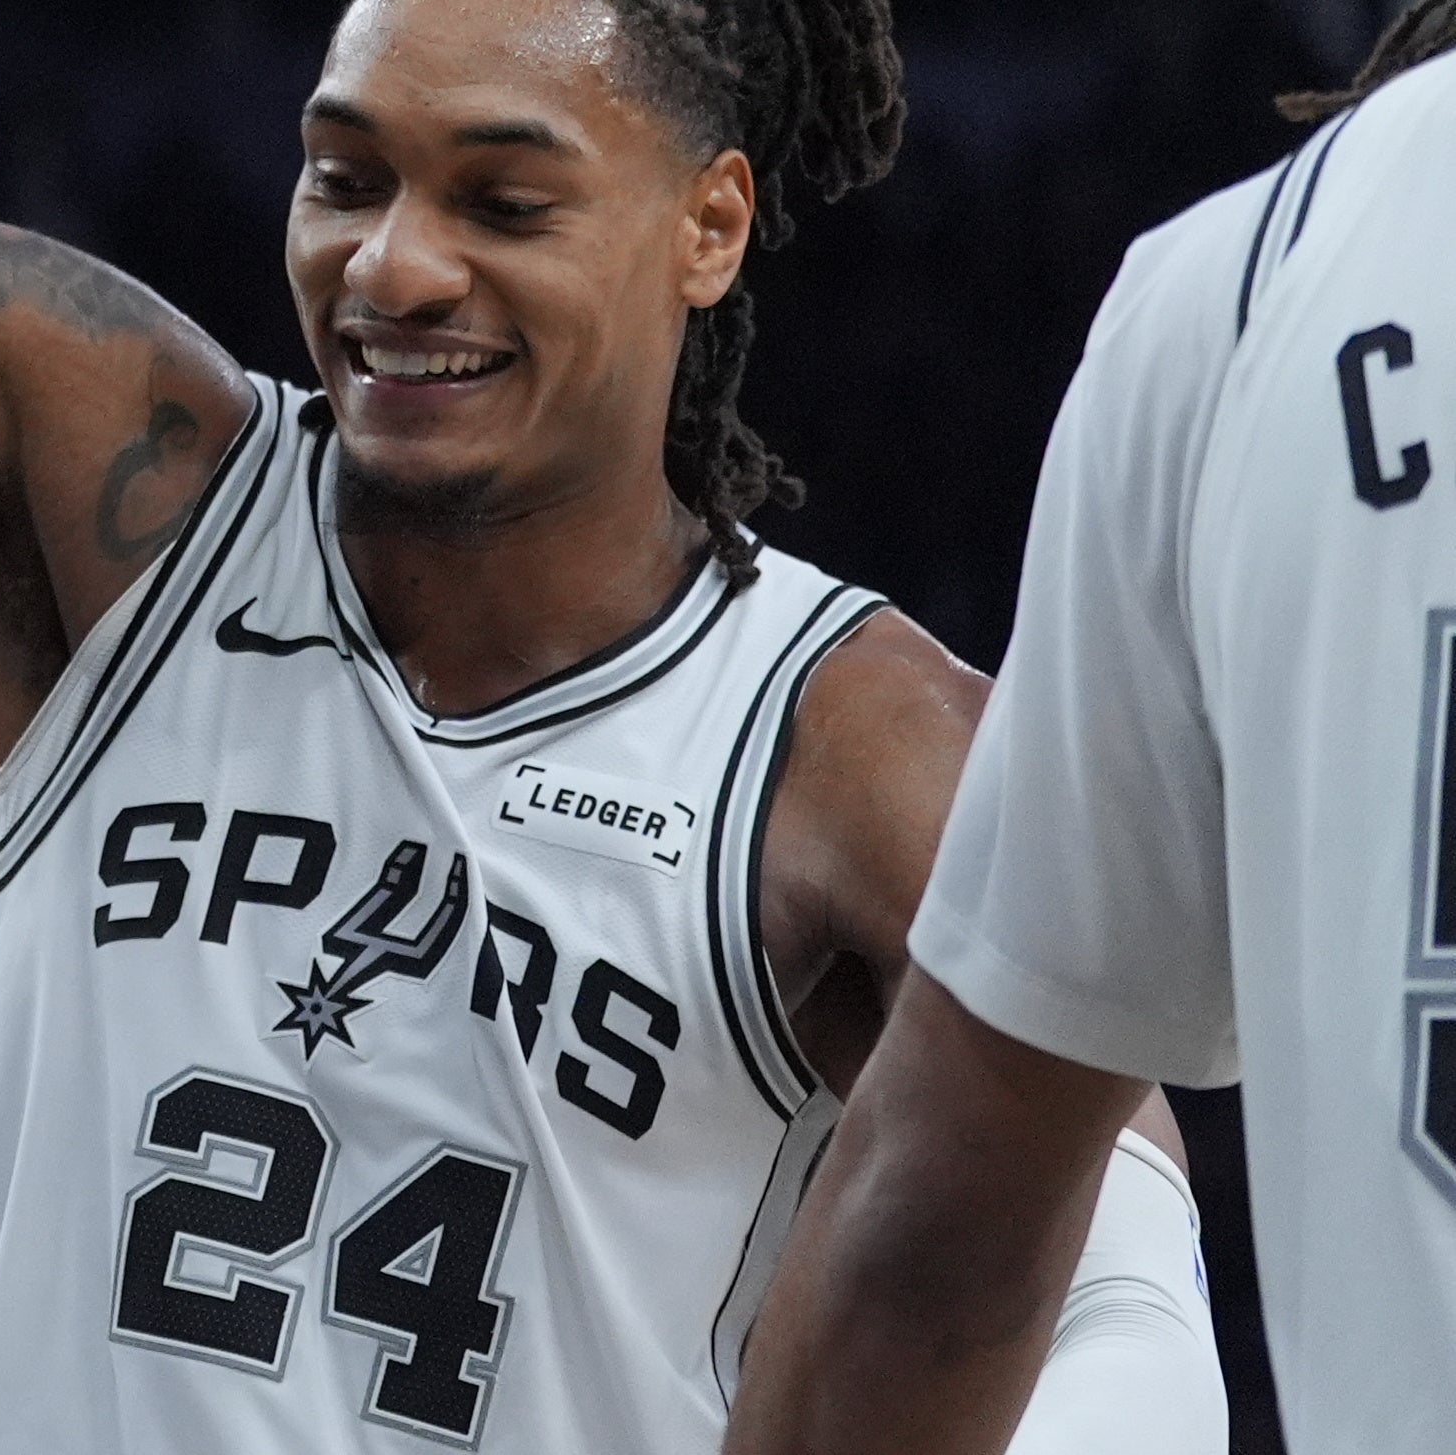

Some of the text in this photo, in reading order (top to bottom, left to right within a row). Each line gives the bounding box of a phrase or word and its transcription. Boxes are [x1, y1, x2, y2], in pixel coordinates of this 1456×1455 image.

[93, 801, 681, 1141] SPURS
[529, 783, 666, 839] LEDGER
[109, 1065, 528, 1452] 24
